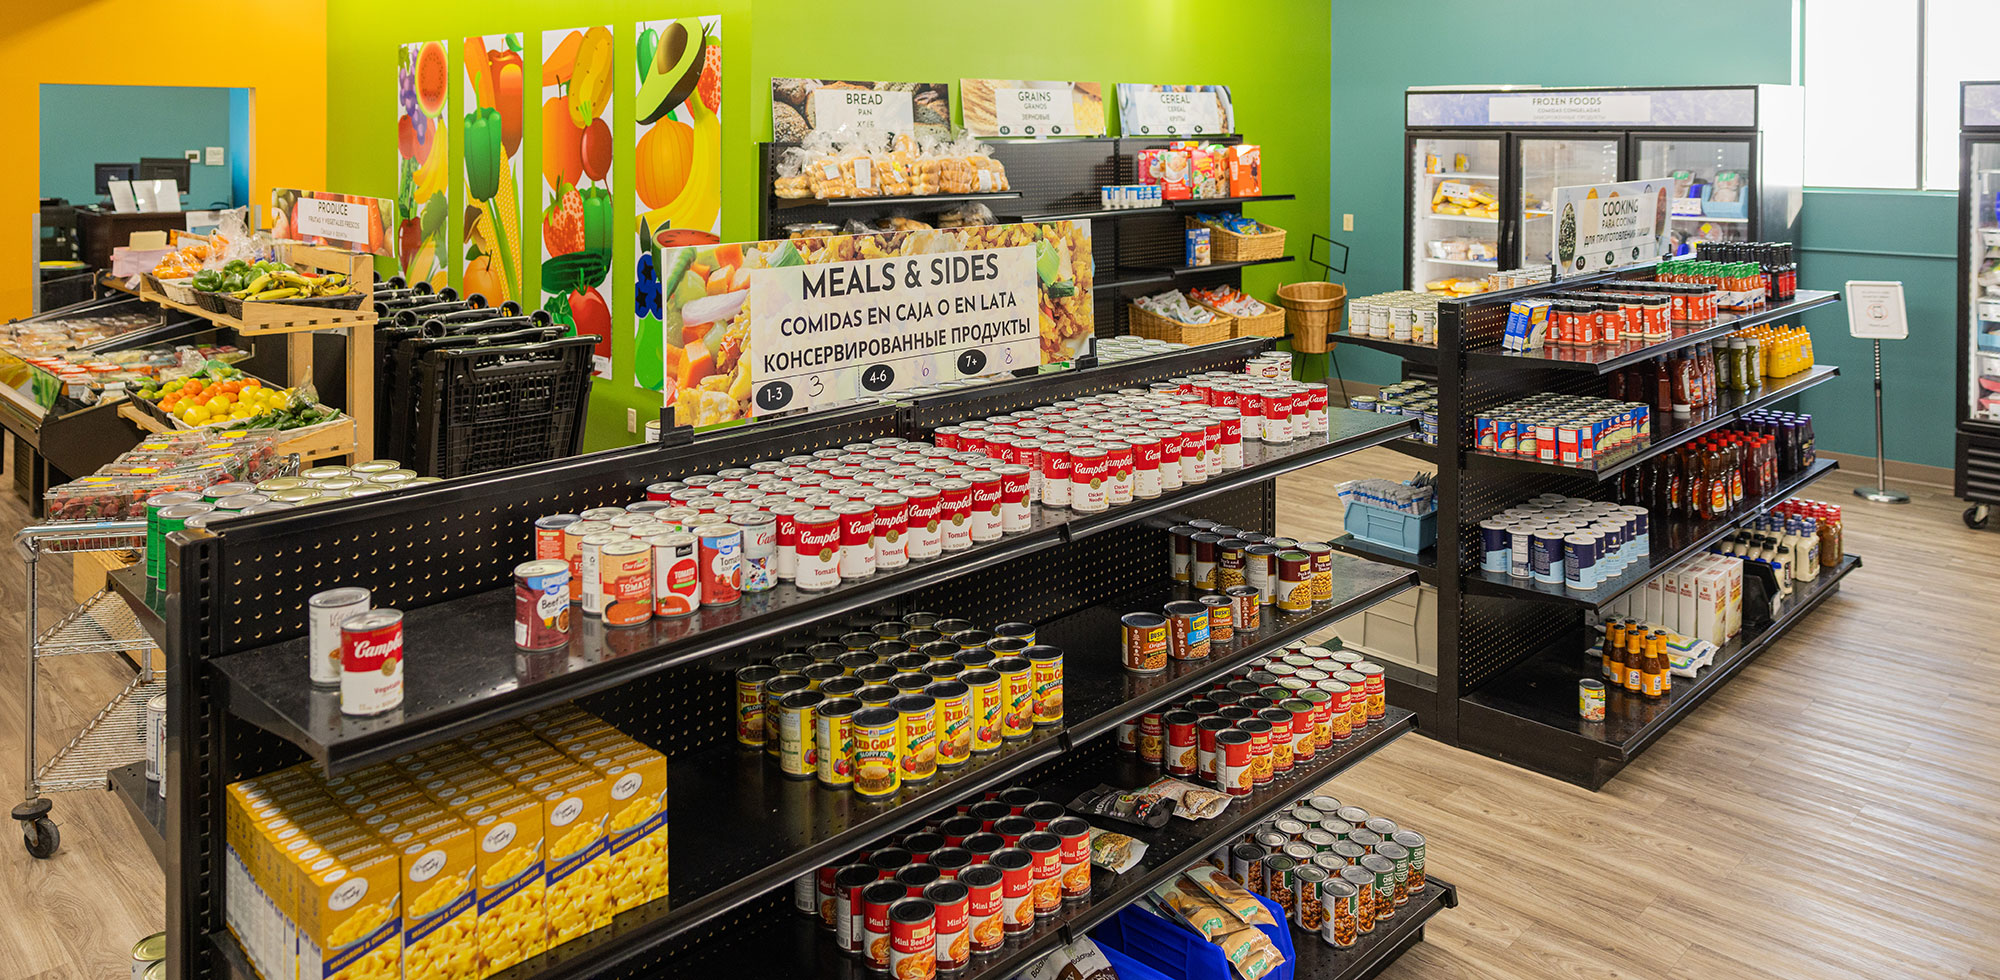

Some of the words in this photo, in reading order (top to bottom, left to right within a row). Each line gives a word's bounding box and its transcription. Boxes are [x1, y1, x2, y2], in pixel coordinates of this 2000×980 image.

[846, 93, 883, 105] BREAD
[1018, 91, 1051, 102] GRAINS
[1161, 94, 1190, 104] CEREAL
[1532, 97, 1566, 105] FROZEN
[1569, 97, 1602, 105] FOODS
[858, 108, 873, 116] PAN
[318, 202, 348, 216] PRODUCE
[1602, 199, 1639, 217] COOKING
[1602, 219, 1615, 229] PARA
[801, 261, 896, 300] MEALS
[904, 259, 922, 287] &
[930, 253, 999, 285] SIDES
[780, 312, 862, 337] COMIDAS
[868, 307, 890, 326] EN
[895, 302, 933, 322] CAJA
[938, 299, 949, 316] O
[955, 296, 975, 314] EN
[980, 291, 1016, 311] LATA
[764, 329, 946, 373] КОНСЕРВИРОВАННЫЕ
[952, 318, 1030, 344] ПРОДУКТЫ
[966, 355, 977, 368] 7+
[1005, 347, 1013, 364] 8
[921, 360, 930, 377] 6
[870, 370, 887, 384] 4-6
[809, 375, 824, 397] 3
[766, 386, 783, 402] 1-3
[948, 531, 968, 539] Tomato
[881, 548, 903, 556] Tomato
[674, 567, 695, 579] TOMATO
[814, 568, 836, 576] Tomato
[619, 578, 651, 593] TOMATO
[541, 596, 559, 609] Beef
[1035, 670, 1054, 683] RED
[1010, 682, 1027, 695] RED
[982, 695, 999, 708] RED
[944, 709, 963, 722] RED
[905, 724, 926, 737] RED
[853, 735, 870, 750] RED
[870, 734, 897, 751] GOLD
[612, 831, 638, 851] MACARONI
[644, 816, 662, 832] CHEESE
[552, 859, 581, 880] MACARONI
[586, 842, 605, 860] CHEESE
[484, 885, 514, 908] MACARONI
[520, 867, 539, 886] CHEESE
[1013, 883, 1027, 892] Mini
[972, 901, 988, 910] Mini
[411, 915, 443, 940] MACARONI
[450, 896, 471, 914] CHEESE
[869, 917, 884, 927] Mini
[946, 918, 962, 928] Mini
[371, 925, 395, 945] CHEESE
[894, 936, 909, 947] Mini
[910, 935, 926, 947] Beef
